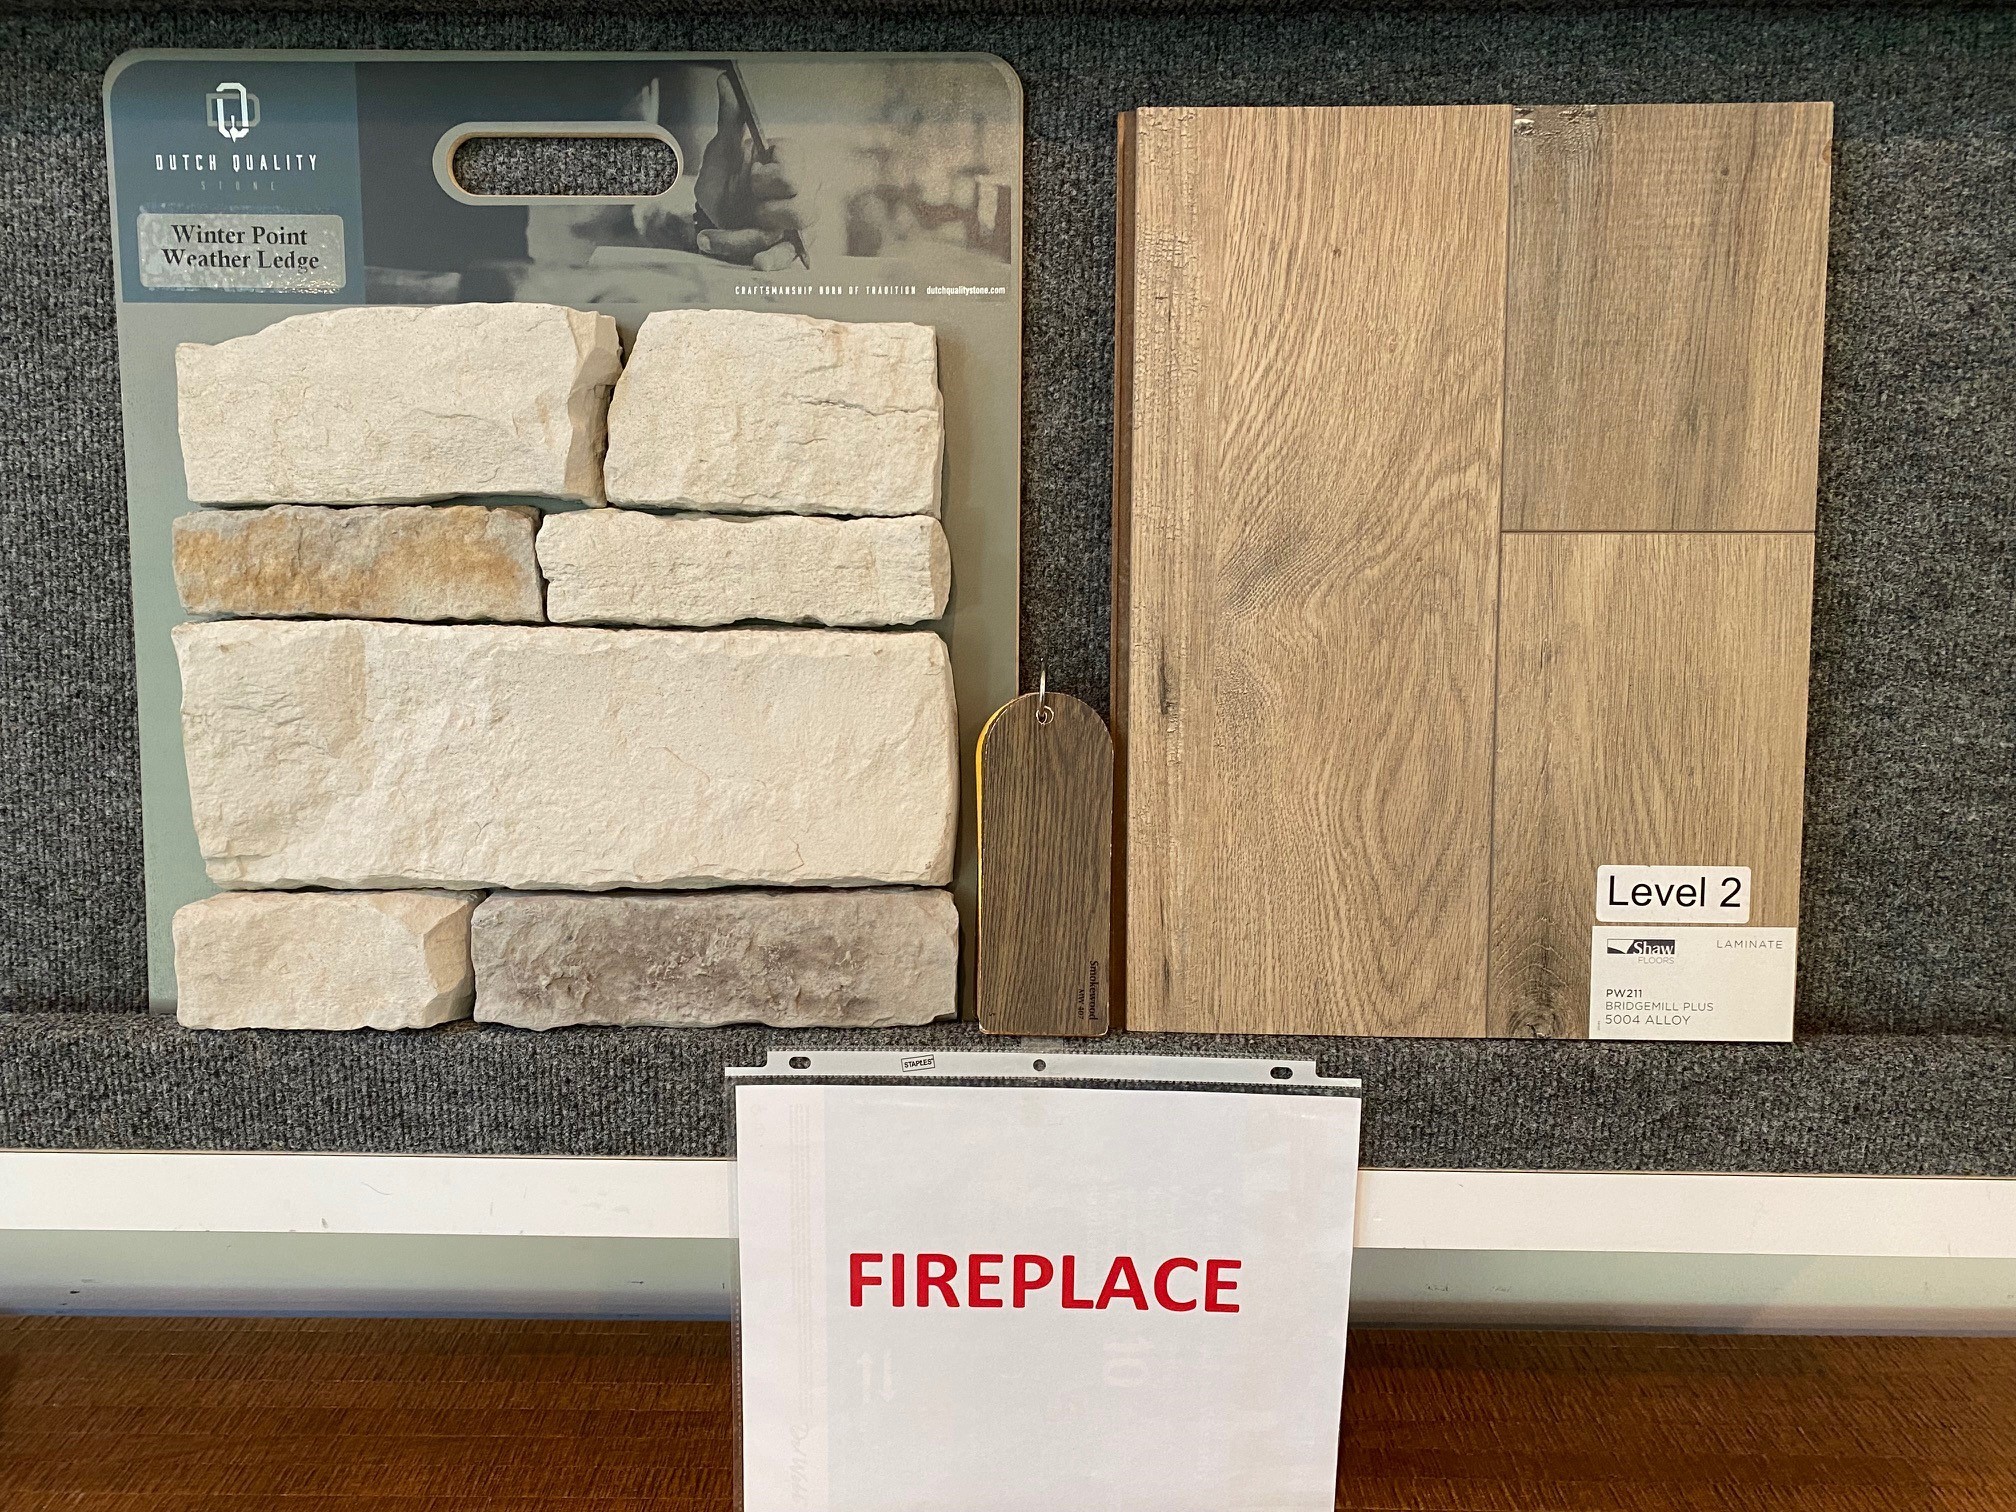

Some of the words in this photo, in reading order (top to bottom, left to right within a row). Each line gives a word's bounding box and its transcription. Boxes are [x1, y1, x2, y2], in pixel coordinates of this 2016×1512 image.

[155, 154, 217, 171] DUTCH
[232, 154, 317, 173] QUALITY
[200, 180, 276, 191] STONE
[171, 224, 246, 244] Winter
[251, 226, 308, 245] Point
[161, 248, 251, 268] Weather
[257, 250, 320, 274] Ledge
[734, 285, 813, 295] CRAFTSMANSHIP
[848, 285, 859, 295] OF
[865, 285, 916, 295] TRADITION
[926, 285, 1006, 296] dutchqualitystone.com
[1608, 875, 1706, 907] Level
[1719, 876, 1742, 908] 2
[1632, 940, 1674, 954] Shaw
[1716, 939, 1783, 949] LAMINATE
[1637, 956, 1675, 965] FLOORS
[1088, 960, 1099, 1020] Smokewood
[1606, 988, 1643, 998] PW211
[1605, 1001, 1679, 1011] BRIDGEMILL
[1683, 1002, 1714, 1012] PLUS
[1605, 1014, 1641, 1025] 5004
[1645, 1015, 1691, 1026] ALLOY
[904, 1058, 932, 1068] STAPLES
[849, 1253, 1243, 1313] FIREPLACE
